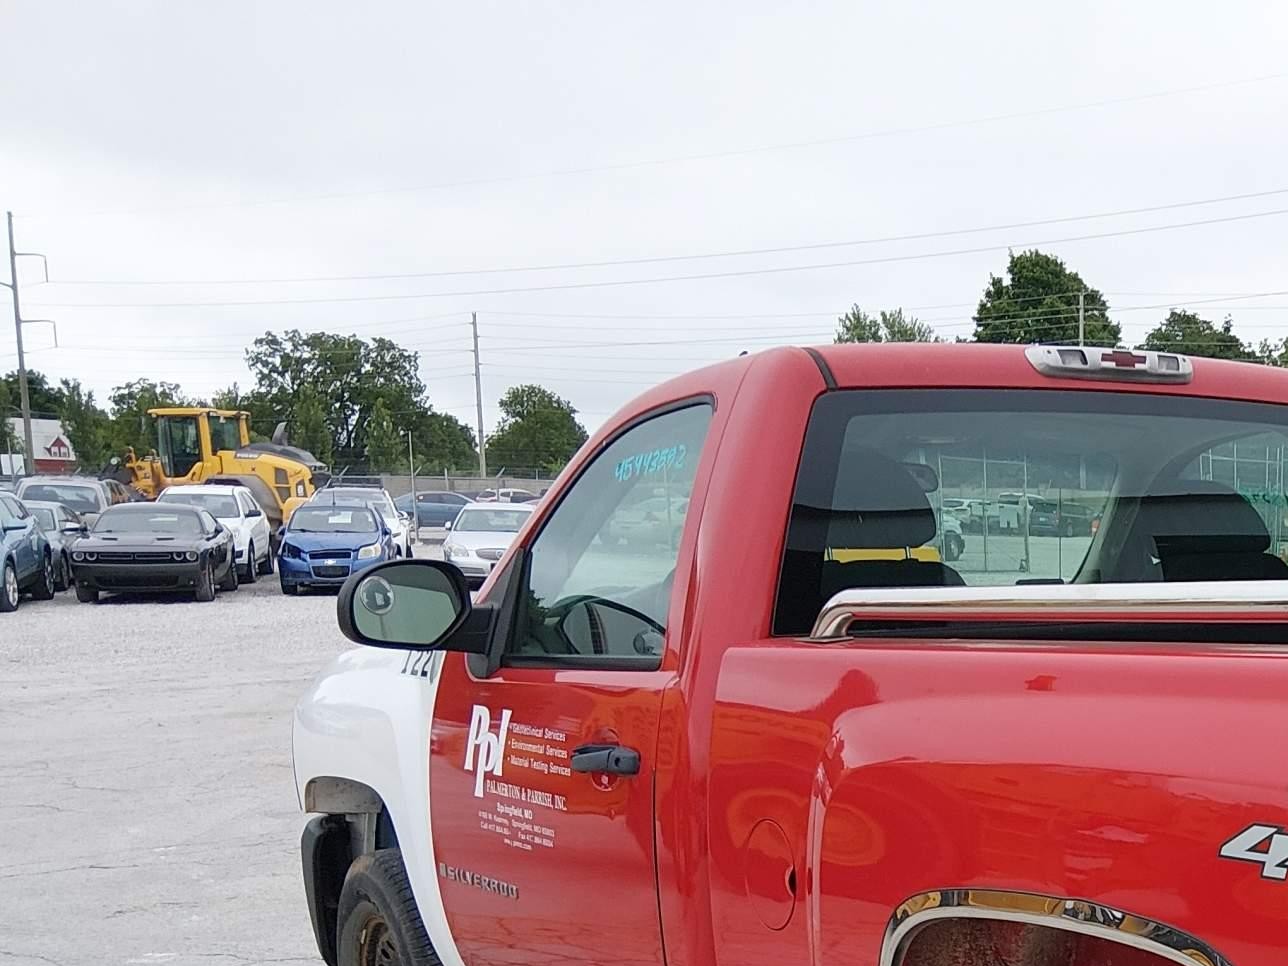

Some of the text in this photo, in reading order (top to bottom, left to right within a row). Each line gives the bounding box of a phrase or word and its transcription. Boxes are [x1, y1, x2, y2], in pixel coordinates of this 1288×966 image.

[530, 758, 549, 774] Testing
[486, 779, 521, 800] PALMERTON
[521, 787, 527, 801] &
[554, 795, 568, 811] INC.
[447, 866, 519, 899] SILVERADO
